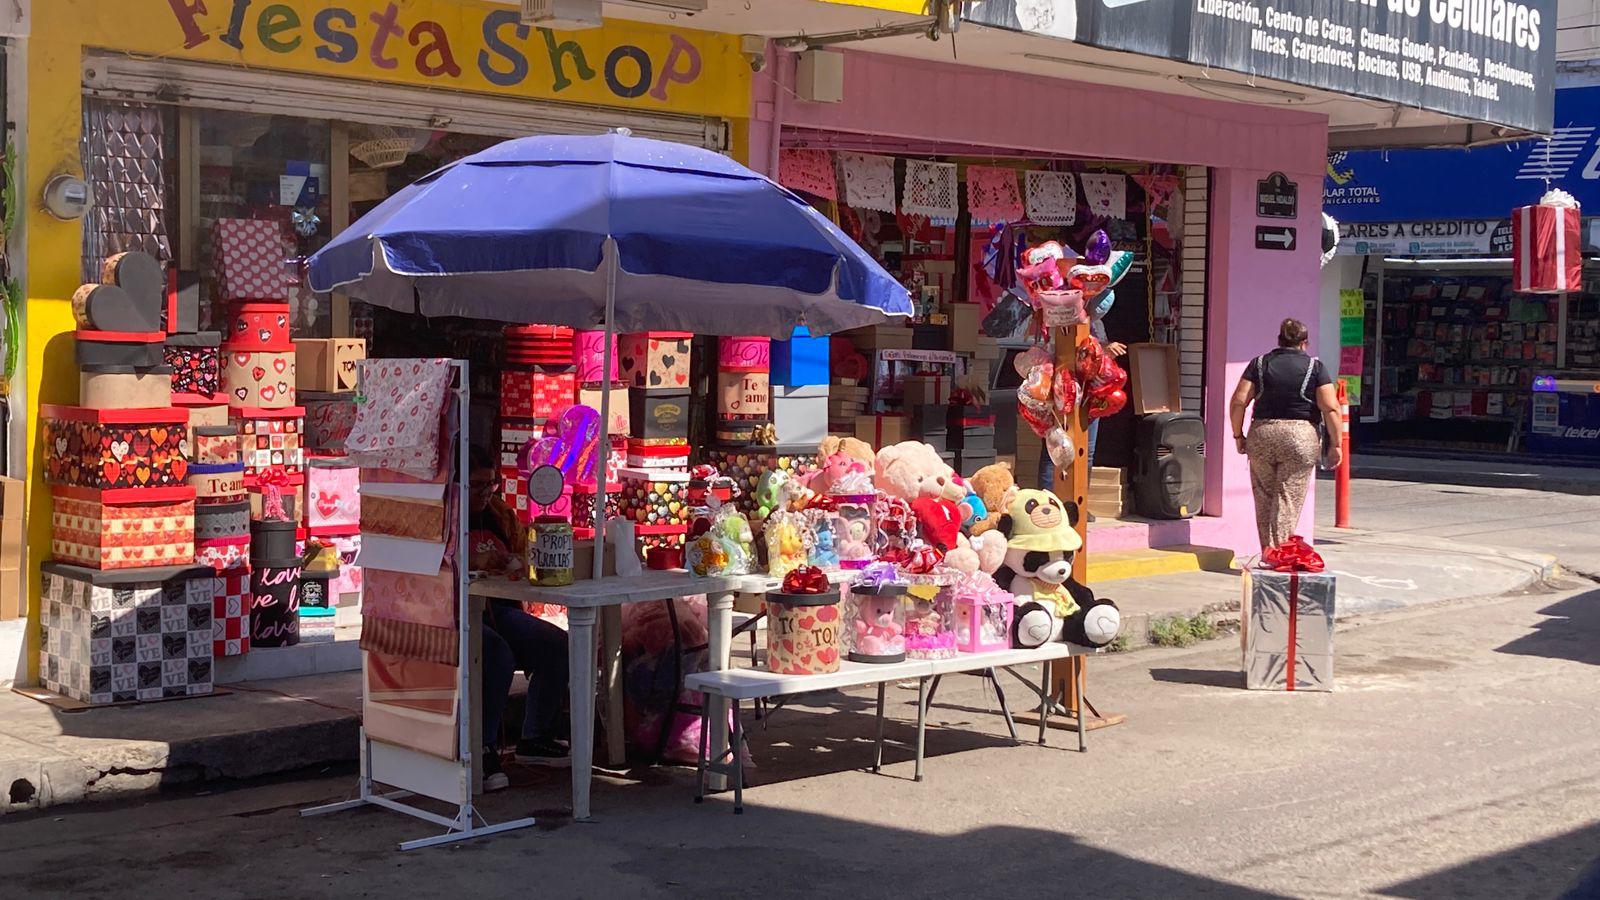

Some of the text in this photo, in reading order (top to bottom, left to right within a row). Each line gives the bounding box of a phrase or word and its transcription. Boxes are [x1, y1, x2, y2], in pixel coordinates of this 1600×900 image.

[1265, 6, 1303, 34] Centro
[1305, 15, 1319, 37] de
[1321, 18, 1355, 47] Carga,
[1360, 27, 1400, 55] Cuentas
[1401, 37, 1436, 66] Google,
[1438, 46, 1480, 76] Pantallas,
[1484, 58, 1535, 91] Desbloqueos,
[1251, 29, 1289, 58] Micas,
[1292, 37, 1356, 72] Cargadores,
[1358, 51, 1399, 81] Bocinas,
[1402, 60, 1424, 87] USB,
[1425, 66, 1472, 97] Audífonos,
[1349, 187, 1379, 197] TOTAL
[1394, 223, 1405, 237] A
[1411, 221, 1487, 237] CREDITO
[743, 378, 758, 391] Te
[208, 478, 228, 494] Te
